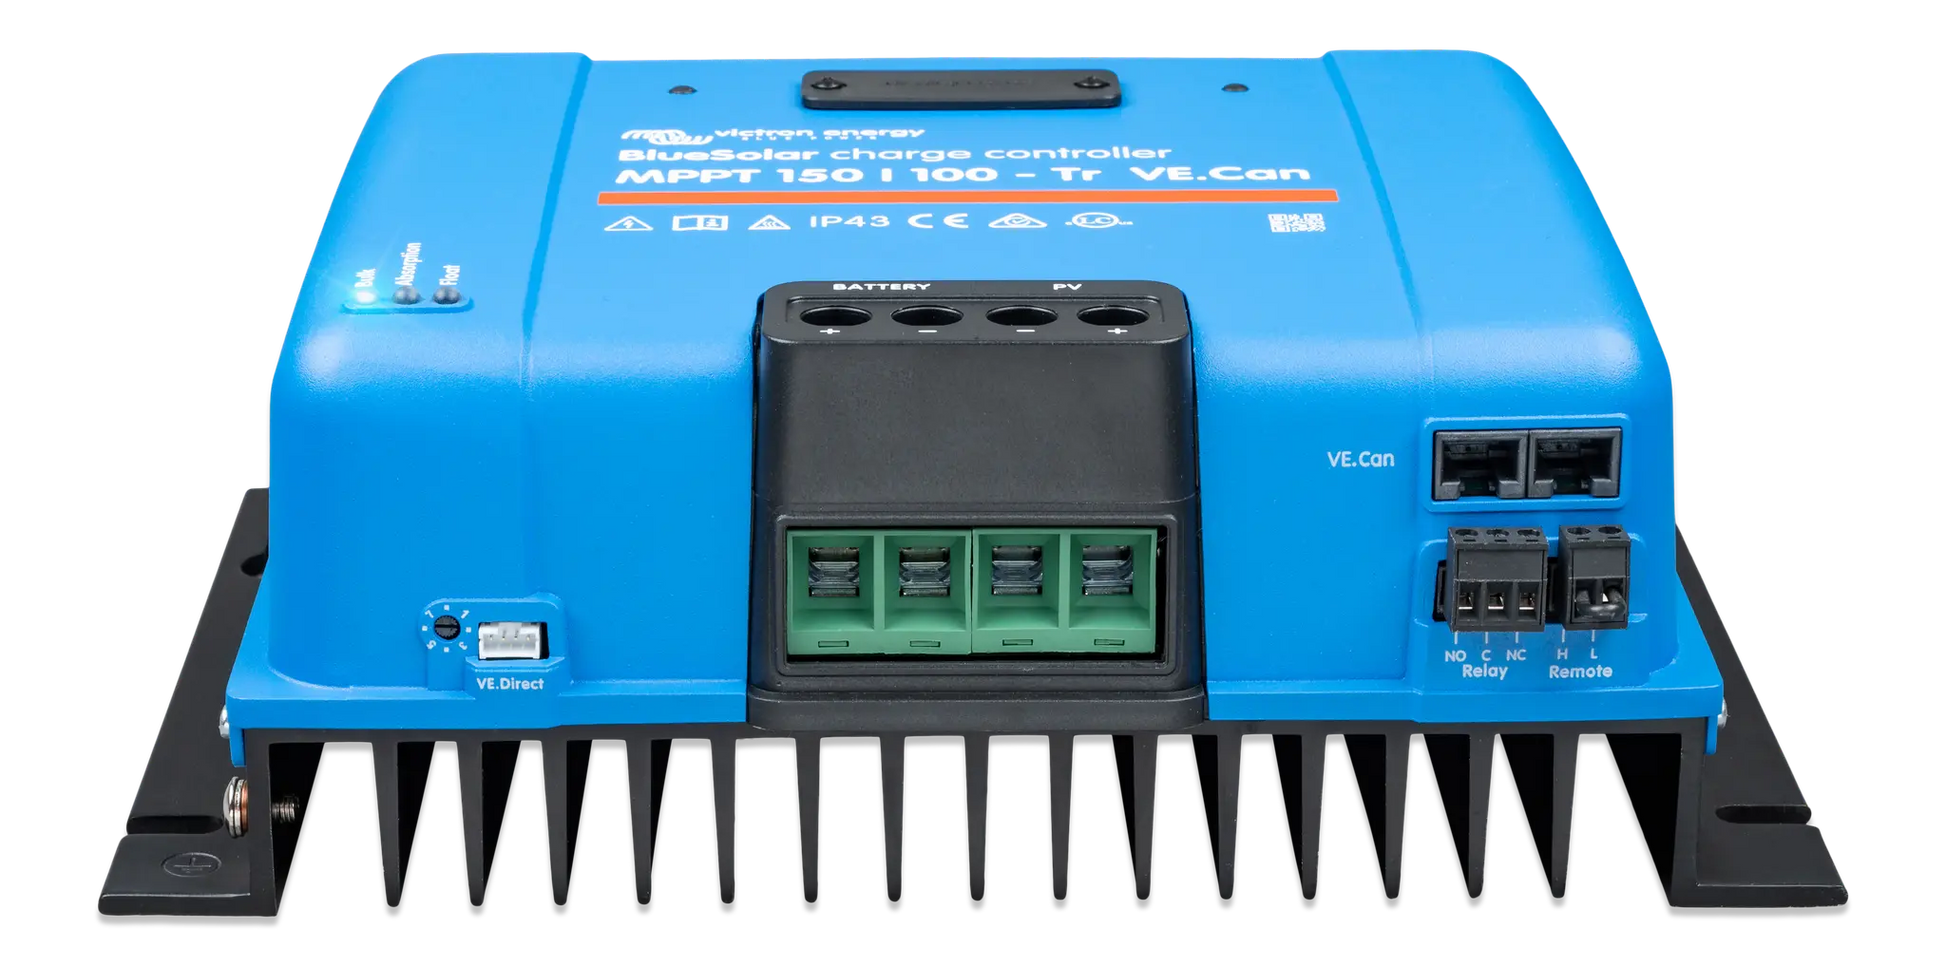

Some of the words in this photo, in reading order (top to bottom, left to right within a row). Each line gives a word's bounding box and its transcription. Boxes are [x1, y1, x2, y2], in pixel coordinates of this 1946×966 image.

[714, 128, 814, 137] victron
[823, 128, 925, 139] energy
[618, 148, 820, 161] BlueSolar
[830, 148, 972, 163] charge
[984, 146, 1172, 160] controller
[615, 168, 762, 184] MPPT
[776, 167, 864, 183] 150
[910, 167, 998, 182] 100
[1050, 166, 1102, 182] Tr
[1129, 166, 1311, 182] VE.Can
[810, 215, 890, 228] IP43
[395, 242, 422, 286] Absorption
[438, 264, 461, 286] Float
[832, 283, 931, 291] BATTERY
[1053, 283, 1083, 291] PV
[1327, 450, 1395, 468] VE.Can
[1444, 650, 1467, 662] NO
[1481, 650, 1492, 662] C
[1506, 649, 1527, 662] NC
[1556, 648, 1569, 660] H
[1590, 648, 1598, 660] L
[1462, 663, 1509, 681] Relay
[1549, 664, 1613, 679] Remote
[476, 677, 545, 690] VE.Direct
